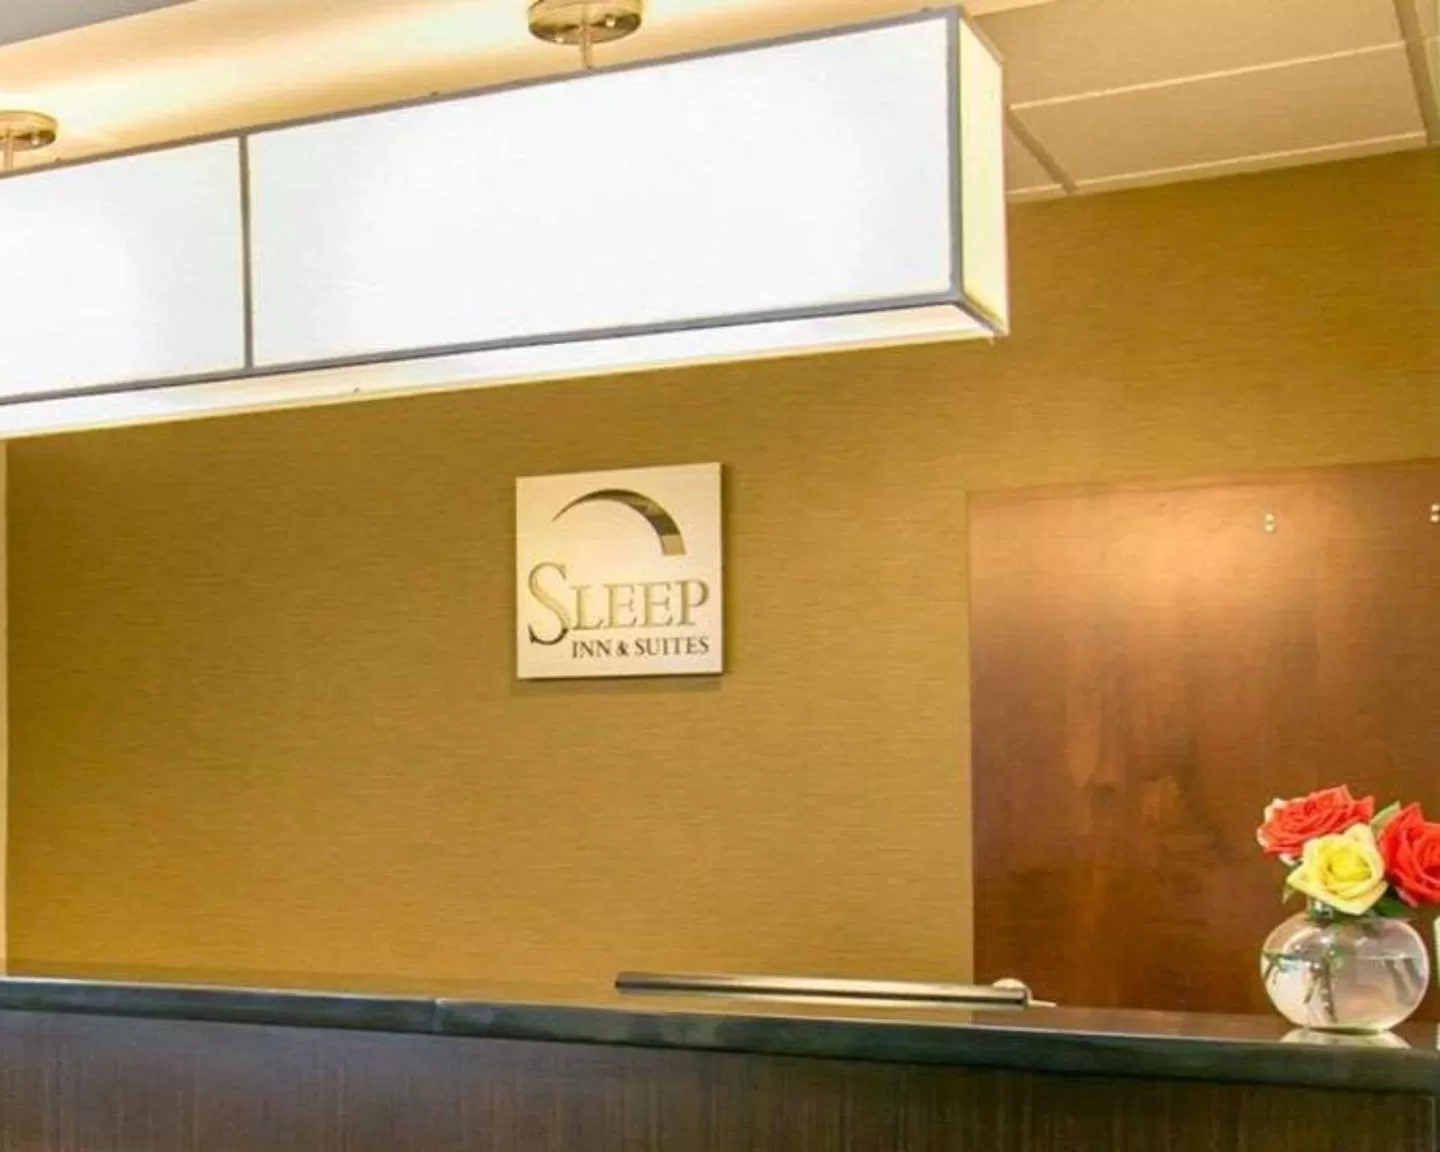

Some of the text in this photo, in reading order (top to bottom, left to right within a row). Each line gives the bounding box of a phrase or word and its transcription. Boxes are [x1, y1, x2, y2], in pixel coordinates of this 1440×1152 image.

[528, 562, 709, 645] SLEEP
[572, 637, 709, 659] INN & SUITES
